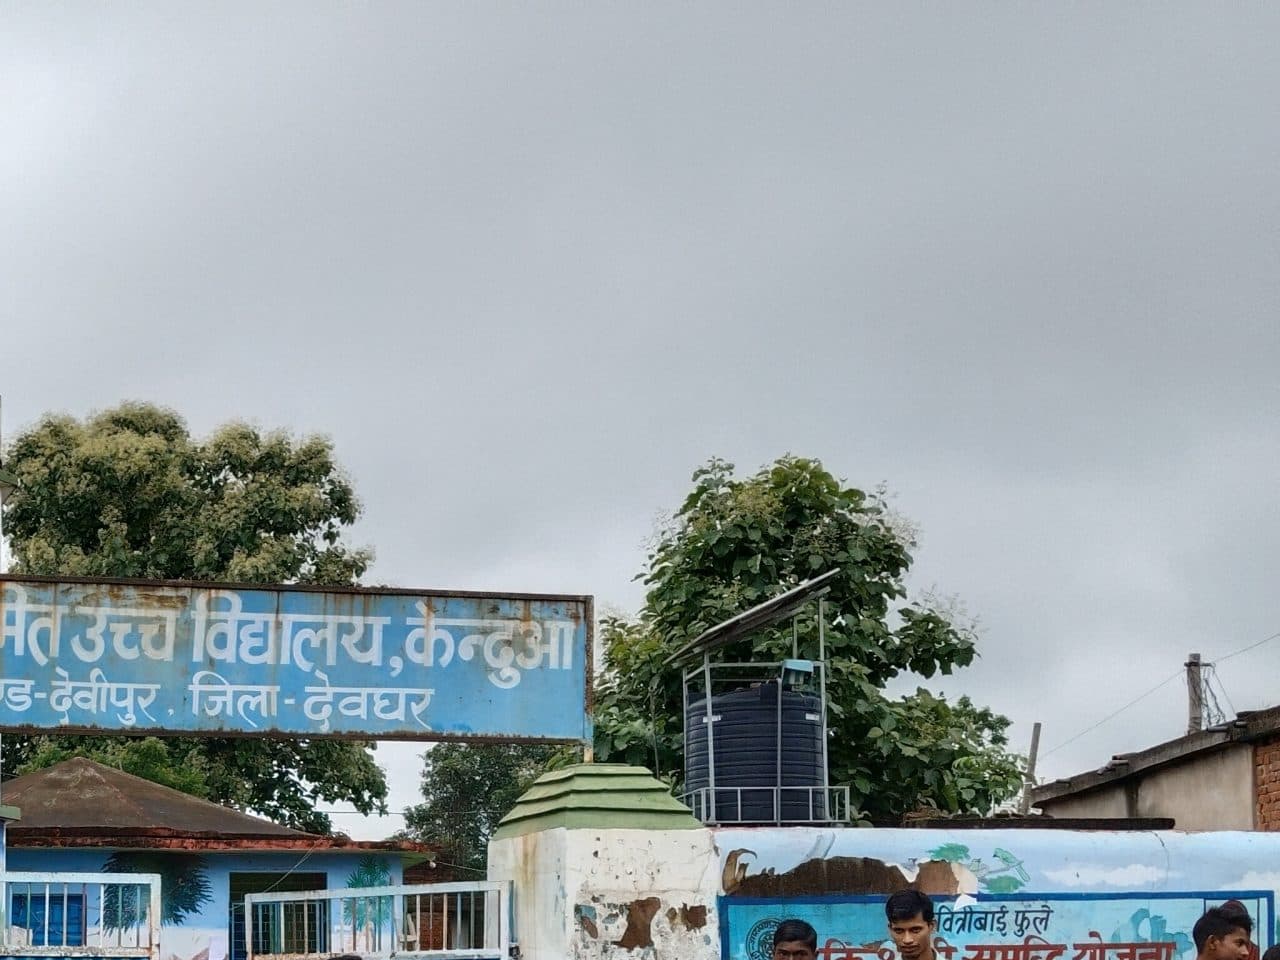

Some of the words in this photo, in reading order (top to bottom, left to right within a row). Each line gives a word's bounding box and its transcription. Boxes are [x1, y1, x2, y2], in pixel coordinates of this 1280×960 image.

[71, 606, 181, 663] उच्च
[935, 905, 1009, 937] वित्रीबाई
[1014, 904, 1054, 937] फुले
